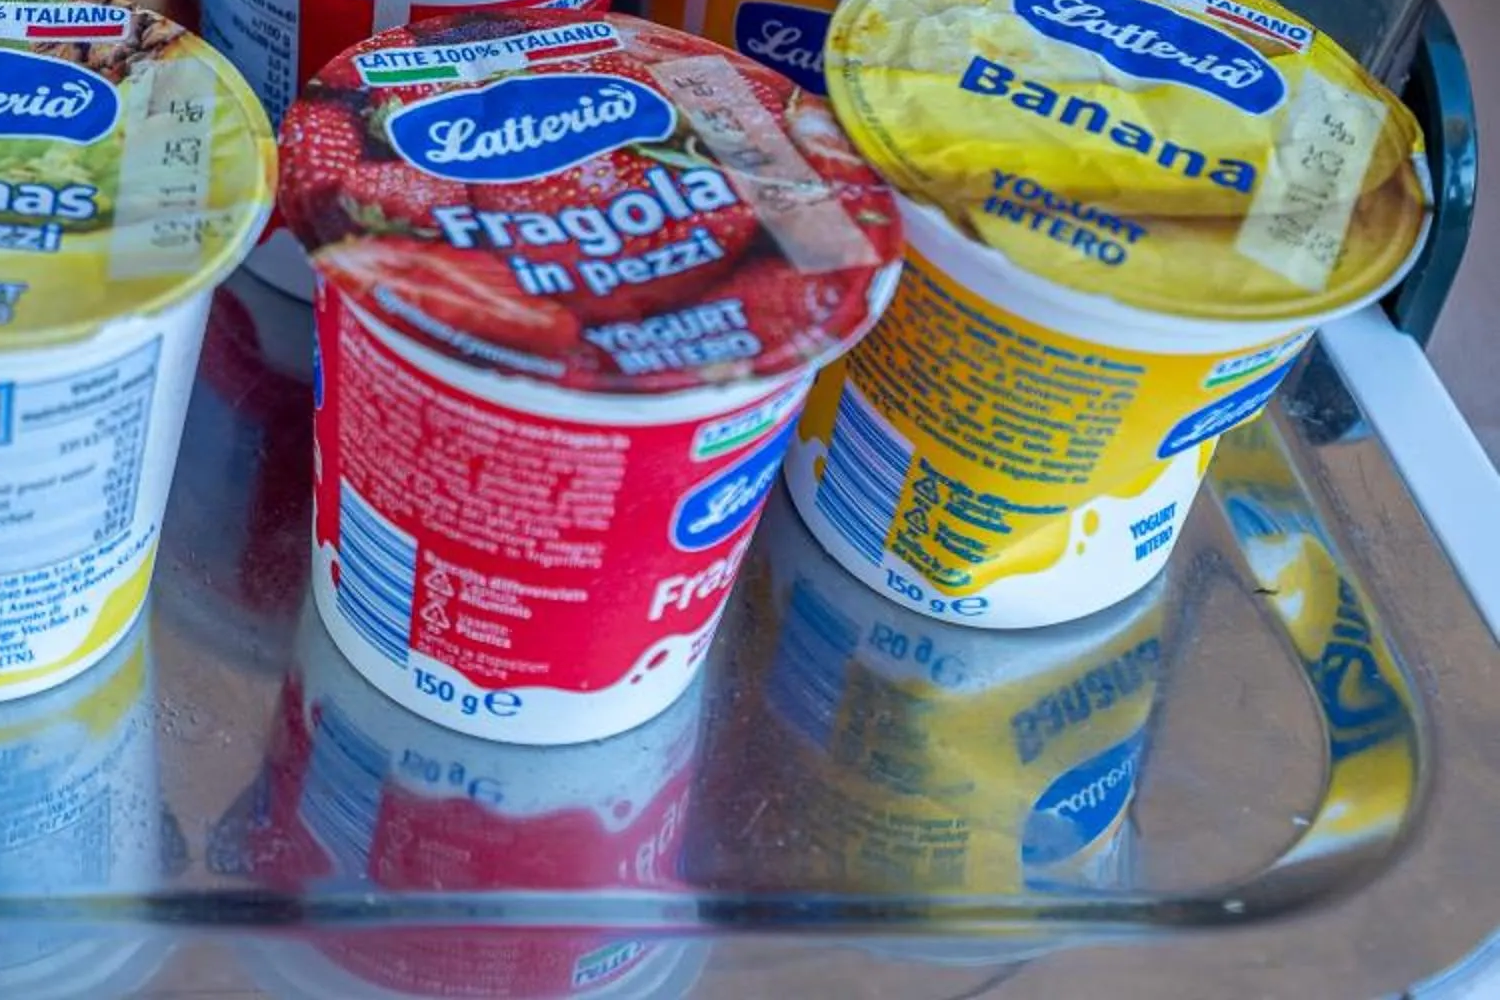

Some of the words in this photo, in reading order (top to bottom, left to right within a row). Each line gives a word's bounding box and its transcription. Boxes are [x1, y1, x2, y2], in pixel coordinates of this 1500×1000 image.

[15, 6, 126, 26] ITALIANO
[358, 49, 430, 70] LATTE
[437, 42, 502, 65] 100%
[503, 21, 614, 55] ITALIANO
[425, 83, 637, 162] Latteria
[957, 55, 1259, 195] Banana
[432, 165, 738, 258] Fragola
[982, 194, 1128, 269] INTERO
[987, 168, 1151, 245] YOGURT
[510, 253, 576, 298] in
[578, 226, 726, 298] pezzi
[585, 297, 749, 348] YOGURT
[616, 325, 764, 376] INTERO
[1129, 501, 1179, 541] YOGURT
[884, 568, 925, 604] 150
[413, 667, 455, 703] 150
